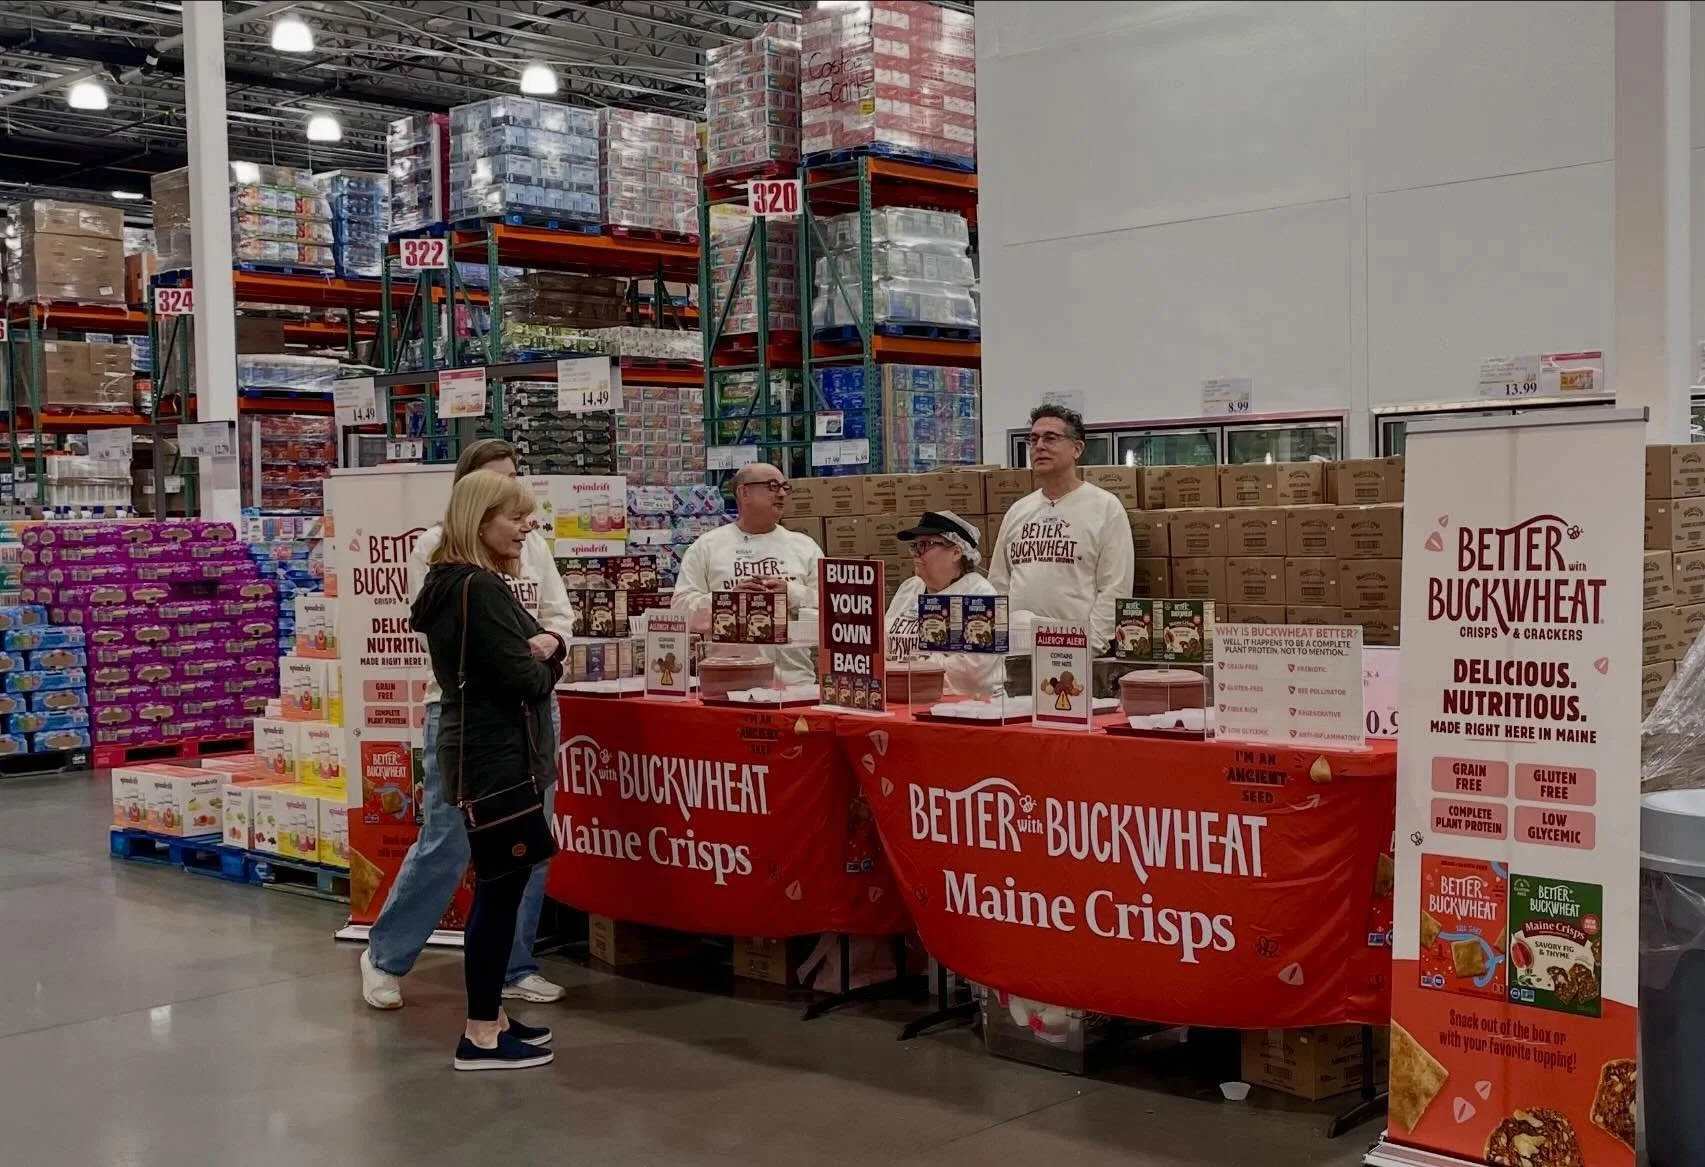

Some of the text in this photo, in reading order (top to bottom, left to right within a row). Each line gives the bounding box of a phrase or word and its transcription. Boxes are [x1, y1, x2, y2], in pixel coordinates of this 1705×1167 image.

[752, 183, 798, 214] 320
[405, 240, 443, 268] 322
[159, 289, 195, 312] 324
[582, 390, 609, 406] 14.49
[1505, 382, 1538, 396] 13.99
[353, 407, 376, 421] 14.49
[1228, 402, 1249, 413] 8.99
[572, 482, 610, 493] spindrift
[1021, 522, 1064, 540] BETTER
[571, 544, 608, 555] spindrift
[1010, 540, 1078, 560] BUCKWHEAT
[1458, 515, 1587, 572] BETTER with
[733, 556, 781, 578] BETTER
[826, 563, 875, 585] BUILD
[830, 593, 872, 615] YOUR
[1428, 577, 1607, 636] BUCKWHEAT
[831, 622, 871, 645] OWN
[1037, 625, 1085, 635] CAUTION
[1216, 626, 1359, 639] WHY IS BUCKWHEAT BETTER?
[1460, 626, 1583, 641] CRISPS & CRACKERS
[1037, 635, 1085, 647] ALLERGY ALERT
[1243, 638, 1249, 646] IT
[1251, 638, 1283, 647] HAPPENS
[1284, 639, 1294, 647] TO
[1295, 639, 1304, 648] BE
[1306, 640, 1312, 648] A
[1312, 640, 1351, 649] COMPLETE
[1225, 646, 1246, 655] PLANT
[1280, 647, 1296, 655] NOT
[1297, 647, 1307, 656] TO
[360, 657, 422, 666] MADE RIGHT HERE
[834, 653, 870, 675] BAG!
[1453, 658, 1578, 689] DELICIOUS.
[376, 682, 395, 691] GRAIN
[378, 692, 393, 700] FREE
[1443, 688, 1588, 723] NUTRITIOUS.
[1430, 720, 1597, 744] MADE RIGHT HERE IN MAINE
[1235, 750, 1277, 766] I'M AN
[1227, 766, 1288, 785] ANCIENT
[1452, 762, 1487, 777] GRAIN
[1533, 769, 1577, 785] GLUTEN
[598, 763, 618, 782] with
[618, 750, 770, 822] BUCKWHEAT
[1455, 777, 1482, 792] FREE
[1540, 785, 1569, 800] FREE
[1242, 789, 1274, 804] SEED
[1449, 805, 1492, 820] COMPLETE
[1542, 812, 1568, 828] LOW
[909, 777, 1268, 885] BETTER with BUCKWHEAT
[1435, 816, 1503, 834] PLANT PROTEIN
[1527, 826, 1582, 845] GLYCEMIC
[551, 812, 753, 886] Maine Crisps
[1440, 874, 1484, 899] BETTER
[1538, 884, 1571, 902] BETTER
[1428, 893, 1498, 921] BUCKWHEAT
[1529, 897, 1581, 918] BUCKWHEAT
[943, 869, 1236, 965] Maine Crisps
[1525, 921, 1586, 941] Maine Crisps
[1535, 941, 1575, 952] SAVORY FIG
[1546, 949, 1570, 960] THYME
[1450, 1008, 1567, 1046] Snack out of the box or
[1439, 1030, 1577, 1074] with your favorite topping!
